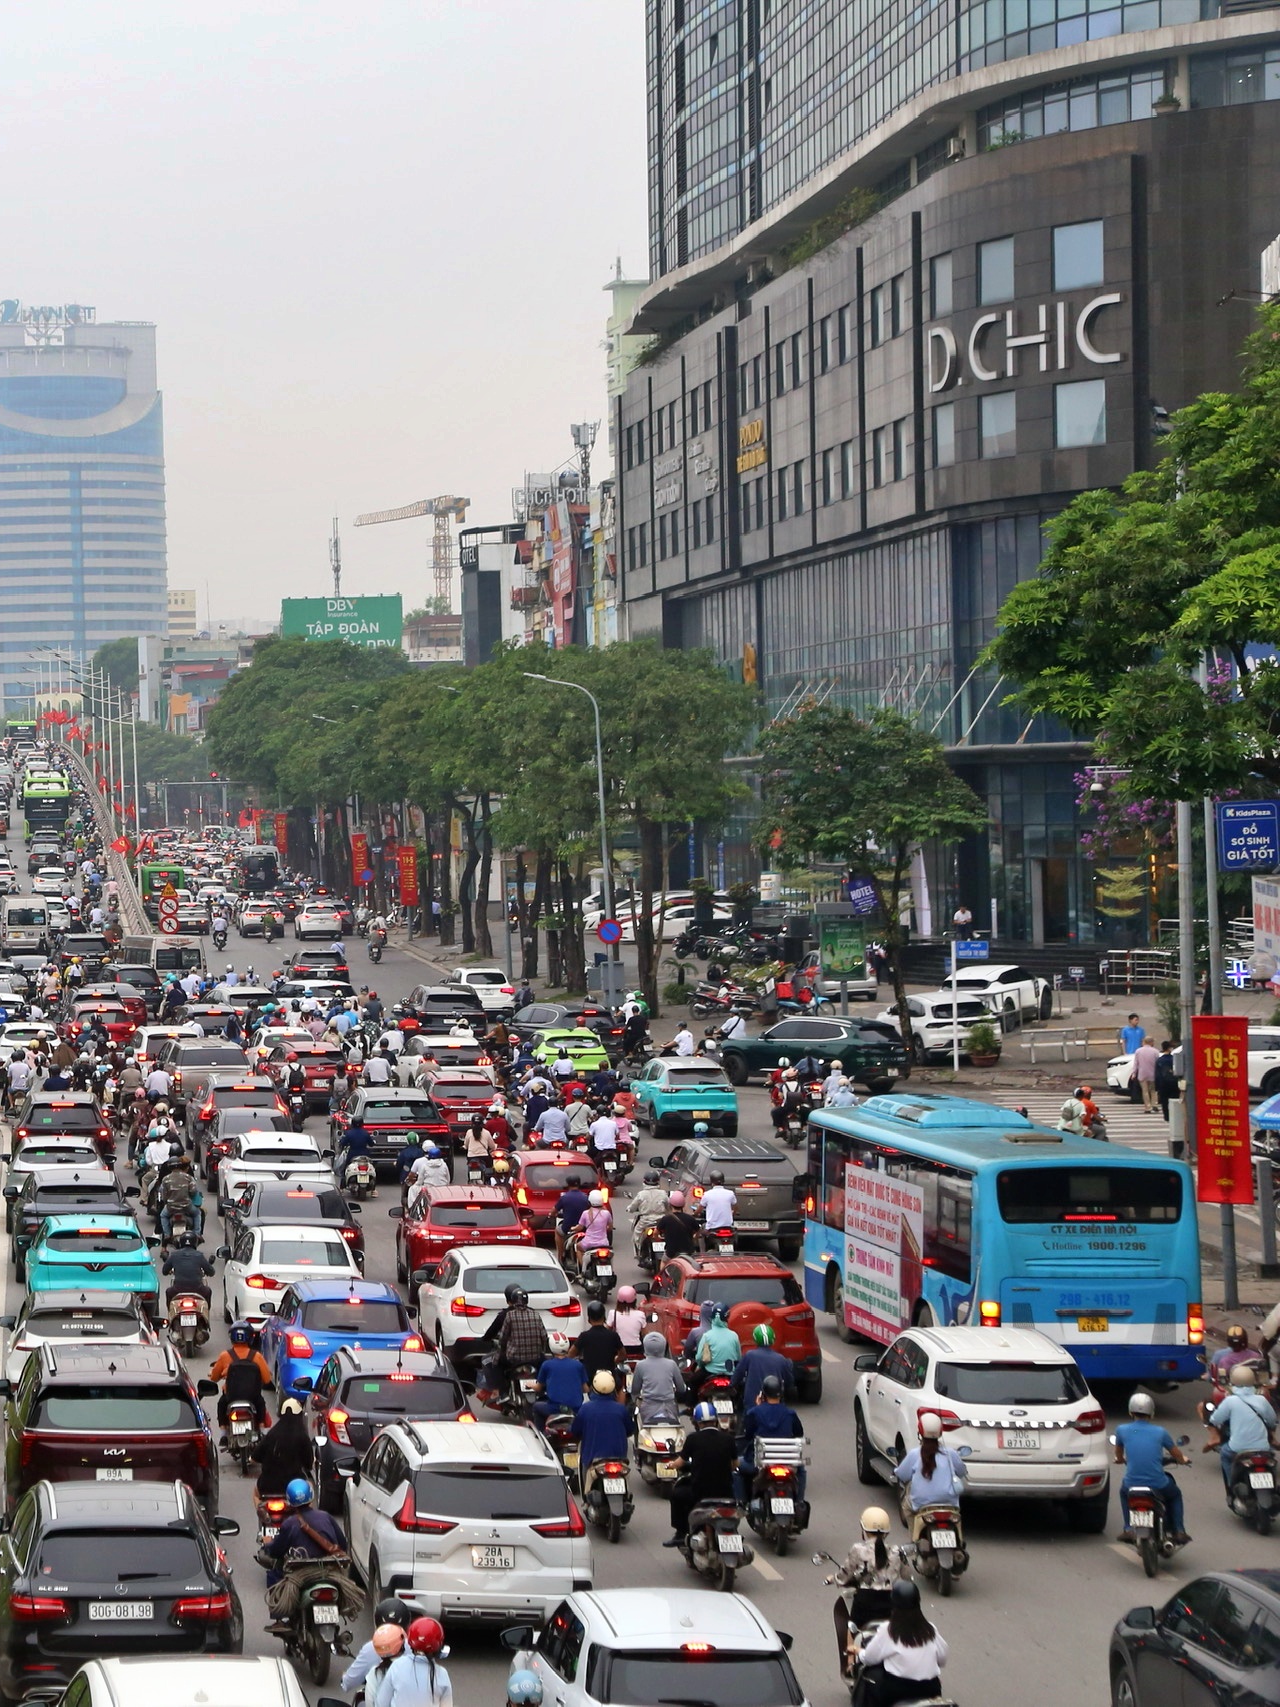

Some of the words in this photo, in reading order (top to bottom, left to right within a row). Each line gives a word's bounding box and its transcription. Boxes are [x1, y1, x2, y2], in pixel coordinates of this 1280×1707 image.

[929, 293, 1120, 392] D.CHIC
[327, 599, 357, 611] DBV
[306, 620, 334, 638] TẬP
[338, 619, 379, 635] ĐOÀN
[1236, 809, 1271, 817] KidsPlaza
[1242, 822, 1258, 835] ĐỒ
[1231, 836, 1245, 846] SƠ
[1246, 836, 1270, 846] SINH
[1227, 847, 1249, 860] GIÁ
[1250, 844, 1275, 859] TỐT
[850, 885, 875, 900] HOTEL
[1203, 1047, 1239, 1069] 19-5
[1051, 1225, 1063, 1234] CT
[1065, 1225, 1077, 1234] XE
[1052, 1242, 1082, 1251] Hotline
[1087, 1242, 1147, 1251] 1900.1296
[1013, 1430, 1029, 1439] 30G
[1007, 1439, 1037, 1448] 871.03
[104, 1448, 126, 1456] KIA
[477, 1558, 510, 1567] 239.16
